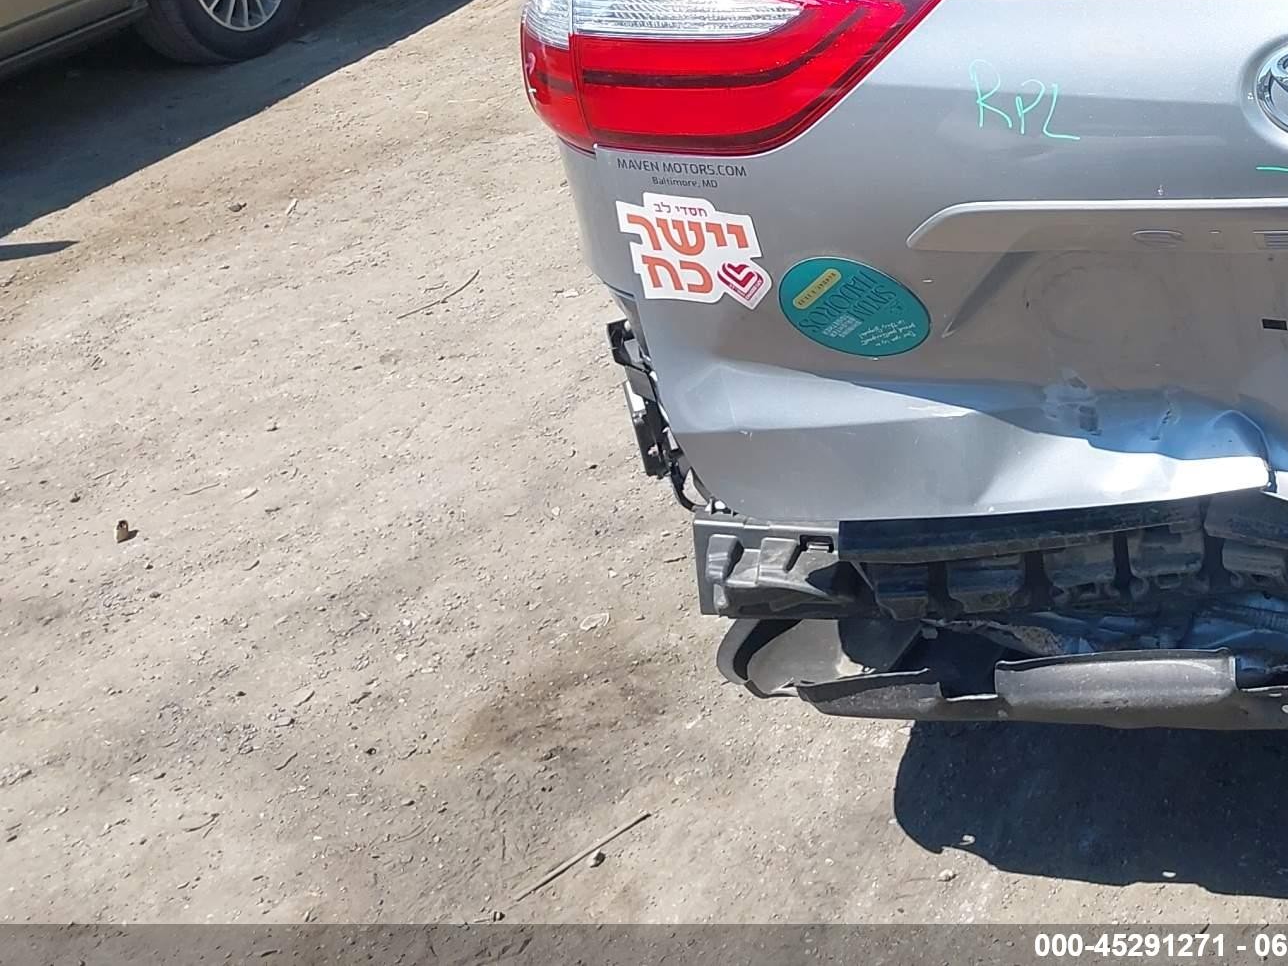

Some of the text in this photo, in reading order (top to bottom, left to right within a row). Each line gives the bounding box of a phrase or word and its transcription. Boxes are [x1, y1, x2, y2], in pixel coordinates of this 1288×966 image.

[617, 157, 747, 177] MAVEN MOTORS.COM
[651, 176, 718, 188] Baltimore, MD
[653, 201, 708, 217] חסדי לב
[641, 254, 713, 294] כח
